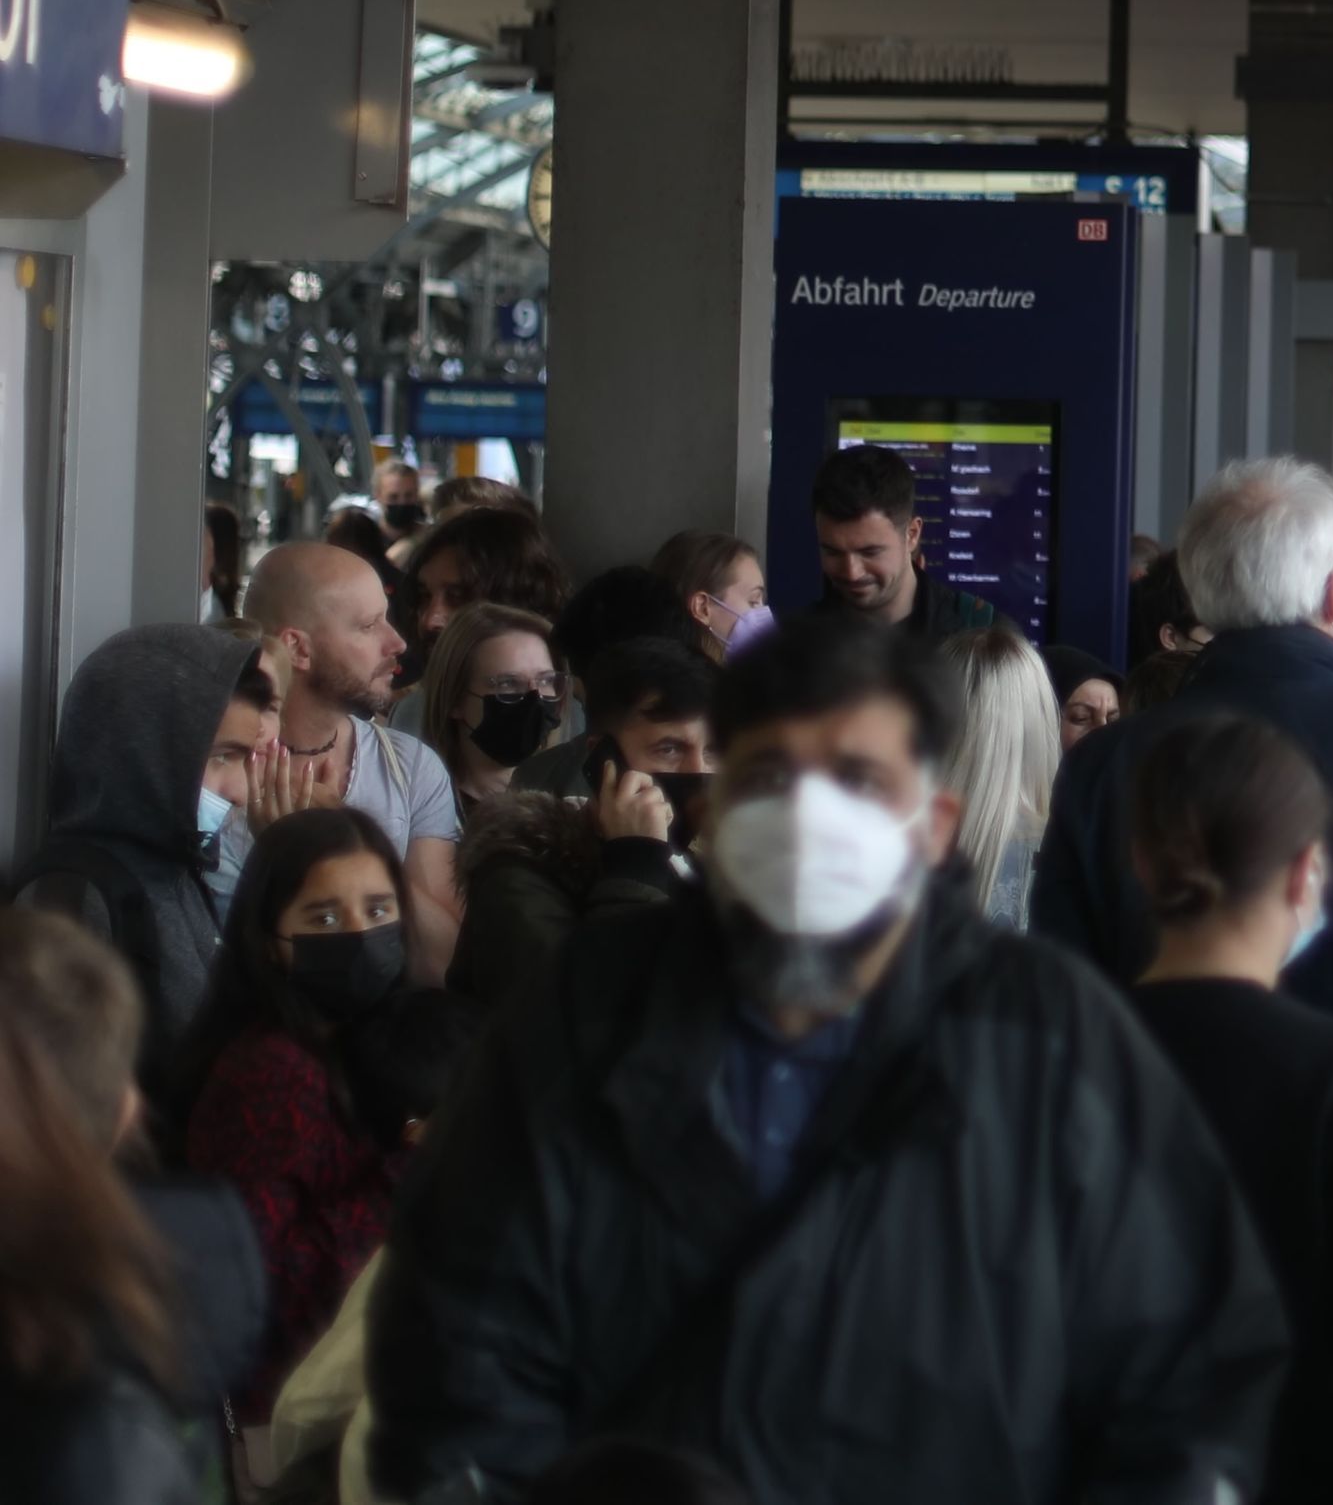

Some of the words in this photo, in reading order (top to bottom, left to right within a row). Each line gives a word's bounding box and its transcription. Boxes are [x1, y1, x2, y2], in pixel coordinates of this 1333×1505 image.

[1134, 175, 1166, 206] 12
[1080, 222, 1106, 239] DB
[790, 275, 905, 307] Abfahrt
[917, 282, 1036, 312] Departure
[512, 298, 540, 339] 9
